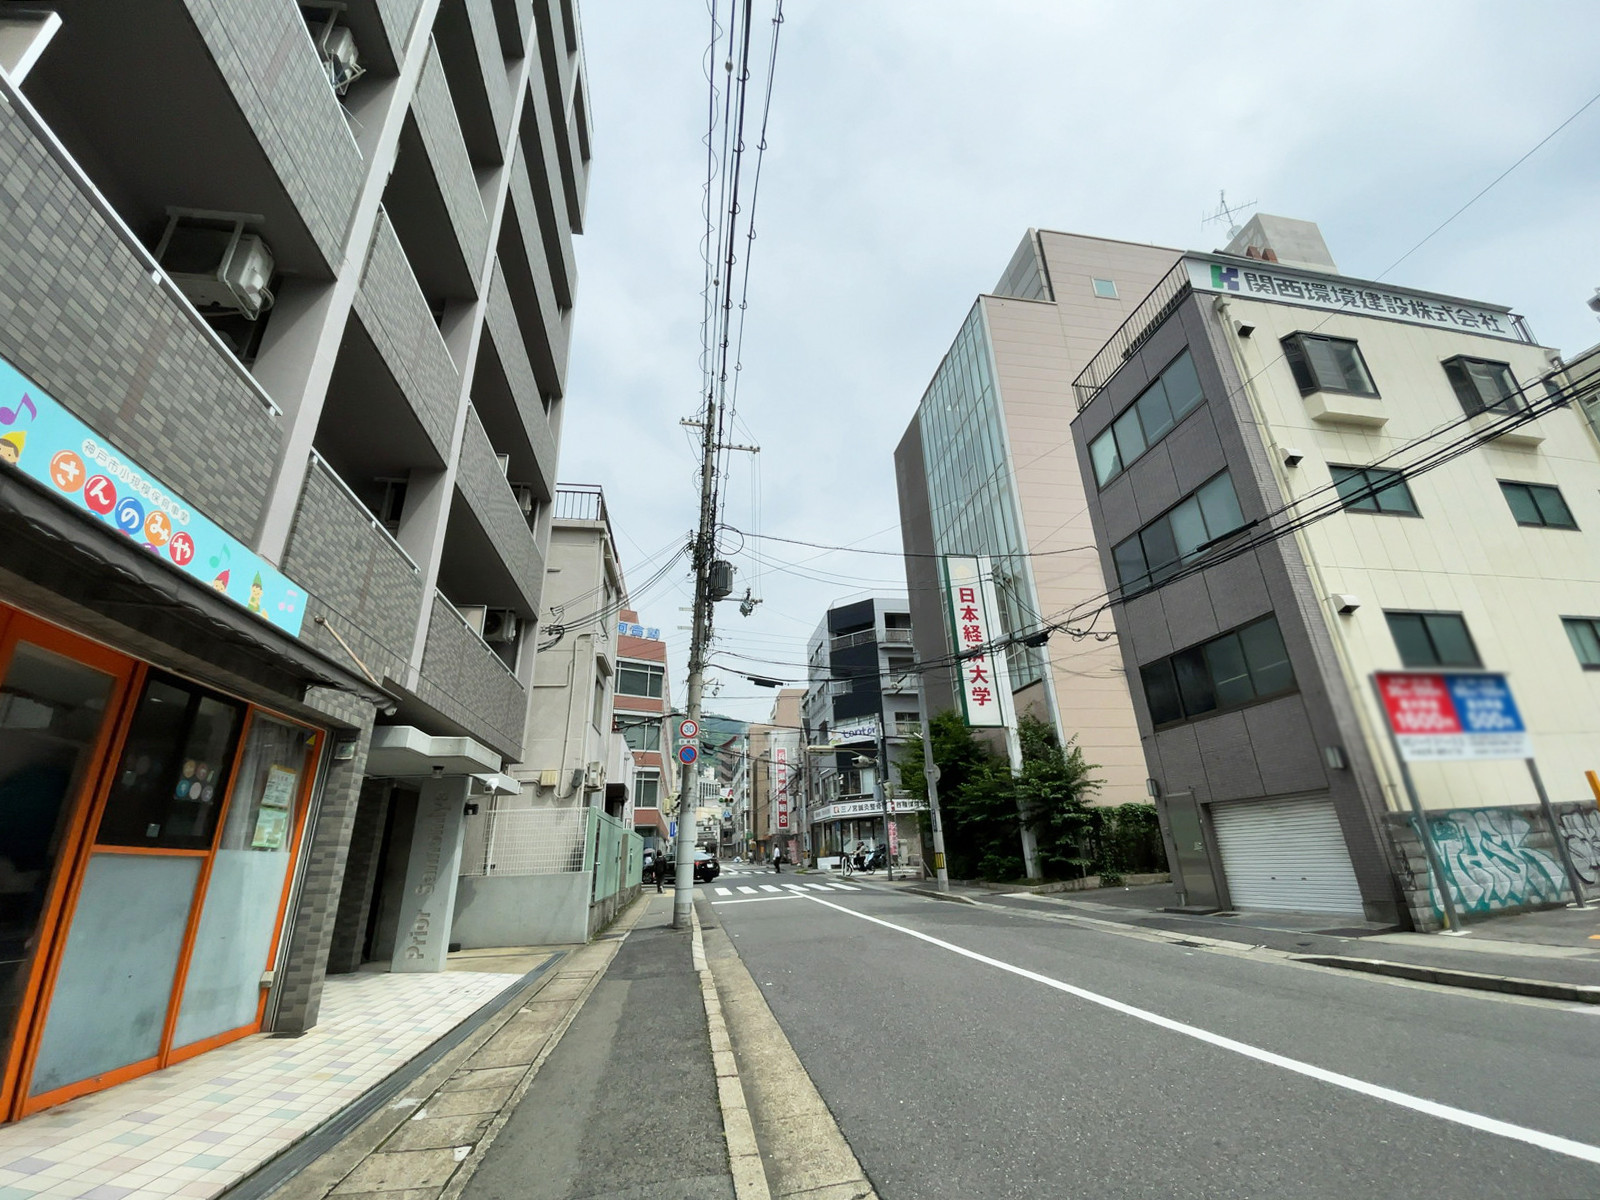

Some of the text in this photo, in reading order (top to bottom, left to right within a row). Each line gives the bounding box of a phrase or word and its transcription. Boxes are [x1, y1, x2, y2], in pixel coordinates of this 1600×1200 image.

[1244, 272, 1506, 334] 関西環境建設株式会社
[56, 460, 191, 561] さんのみや
[683, 724, 695, 733] 30
[405, 909, 431, 959] Prior
